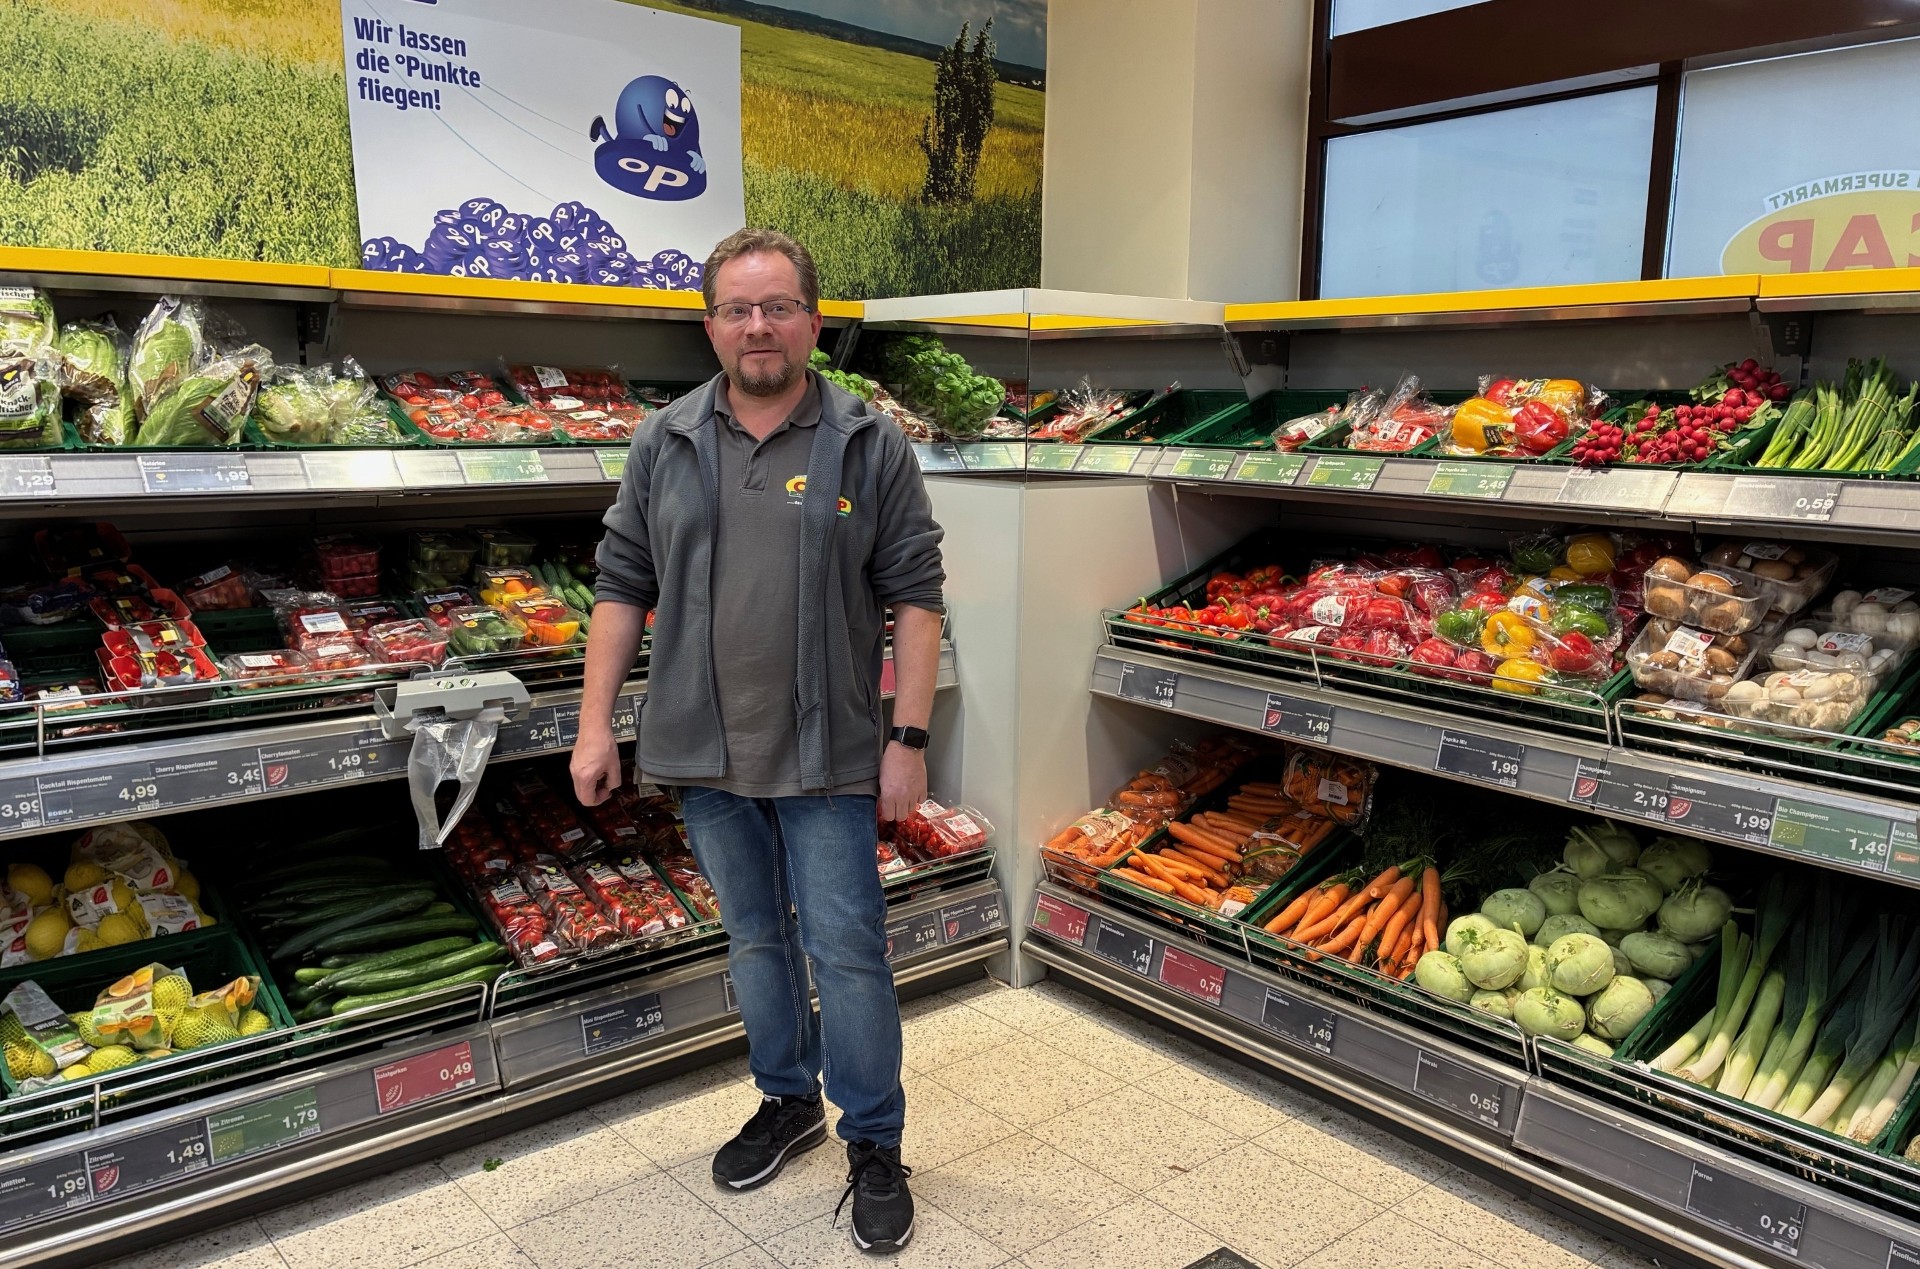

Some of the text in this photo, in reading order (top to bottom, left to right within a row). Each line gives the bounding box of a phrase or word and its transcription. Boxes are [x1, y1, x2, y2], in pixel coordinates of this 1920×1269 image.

[354, 17, 467, 57] Wir lassen
[356, 48, 390, 73] die
[357, 77, 441, 110] fliegen!
[1208, 464, 1229, 472] 0,99
[1278, 467, 1299, 477] 1,49
[15, 474, 54, 487] 1,29
[215, 471, 249, 482] 1,99
[1352, 472, 1375, 481] 2,79
[1477, 479, 1505, 490] 2,49
[1795, 497, 1834, 510] 0,59
[1154, 685, 1173, 697] 1,19
[611, 714, 634, 728] 2,49
[1307, 719, 1330, 732] 1,49
[261, 749, 300, 760] Cherrytomaten
[328, 754, 361, 770] 1,49
[155, 765, 174, 774] Cherry
[175, 759, 218, 771] Rispentomaten
[1491, 760, 1518, 775] 1,99
[1579, 764, 1612, 776] Champignons
[40, 779, 66, 790] Cocktail
[67, 774, 113, 786] Rispentomaten
[118, 784, 158, 802] 4,99
[1633, 791, 1668, 808] 2,19
[1734, 812, 1771, 831] 1,99
[1789, 807, 1830, 821] Champignons
[1895, 829, 1906, 837] Bio
[1849, 837, 1887, 857] 1,49
[980, 909, 999, 923] 1,99
[915, 928, 936, 943] 2,19
[1067, 922, 1085, 937] 1,11
[1132, 949, 1150, 964] 1,49
[1200, 978, 1222, 995] 0,79
[635, 1011, 662, 1029] 2,99
[1307, 1023, 1332, 1042] 1,49
[376, 1066, 408, 1080] Salatgurken
[440, 1061, 472, 1081] 0,49
[1469, 1093, 1499, 1114] 0,55
[220, 1114, 245, 1126] Zitronen
[282, 1109, 318, 1130] 1,79
[88, 1152, 115, 1164] Zitronen
[166, 1142, 205, 1164] 1,49
[1694, 1169, 1713, 1182] Porree
[47, 1176, 86, 1199] 1,99
[1760, 1214, 1799, 1240] 0,79
